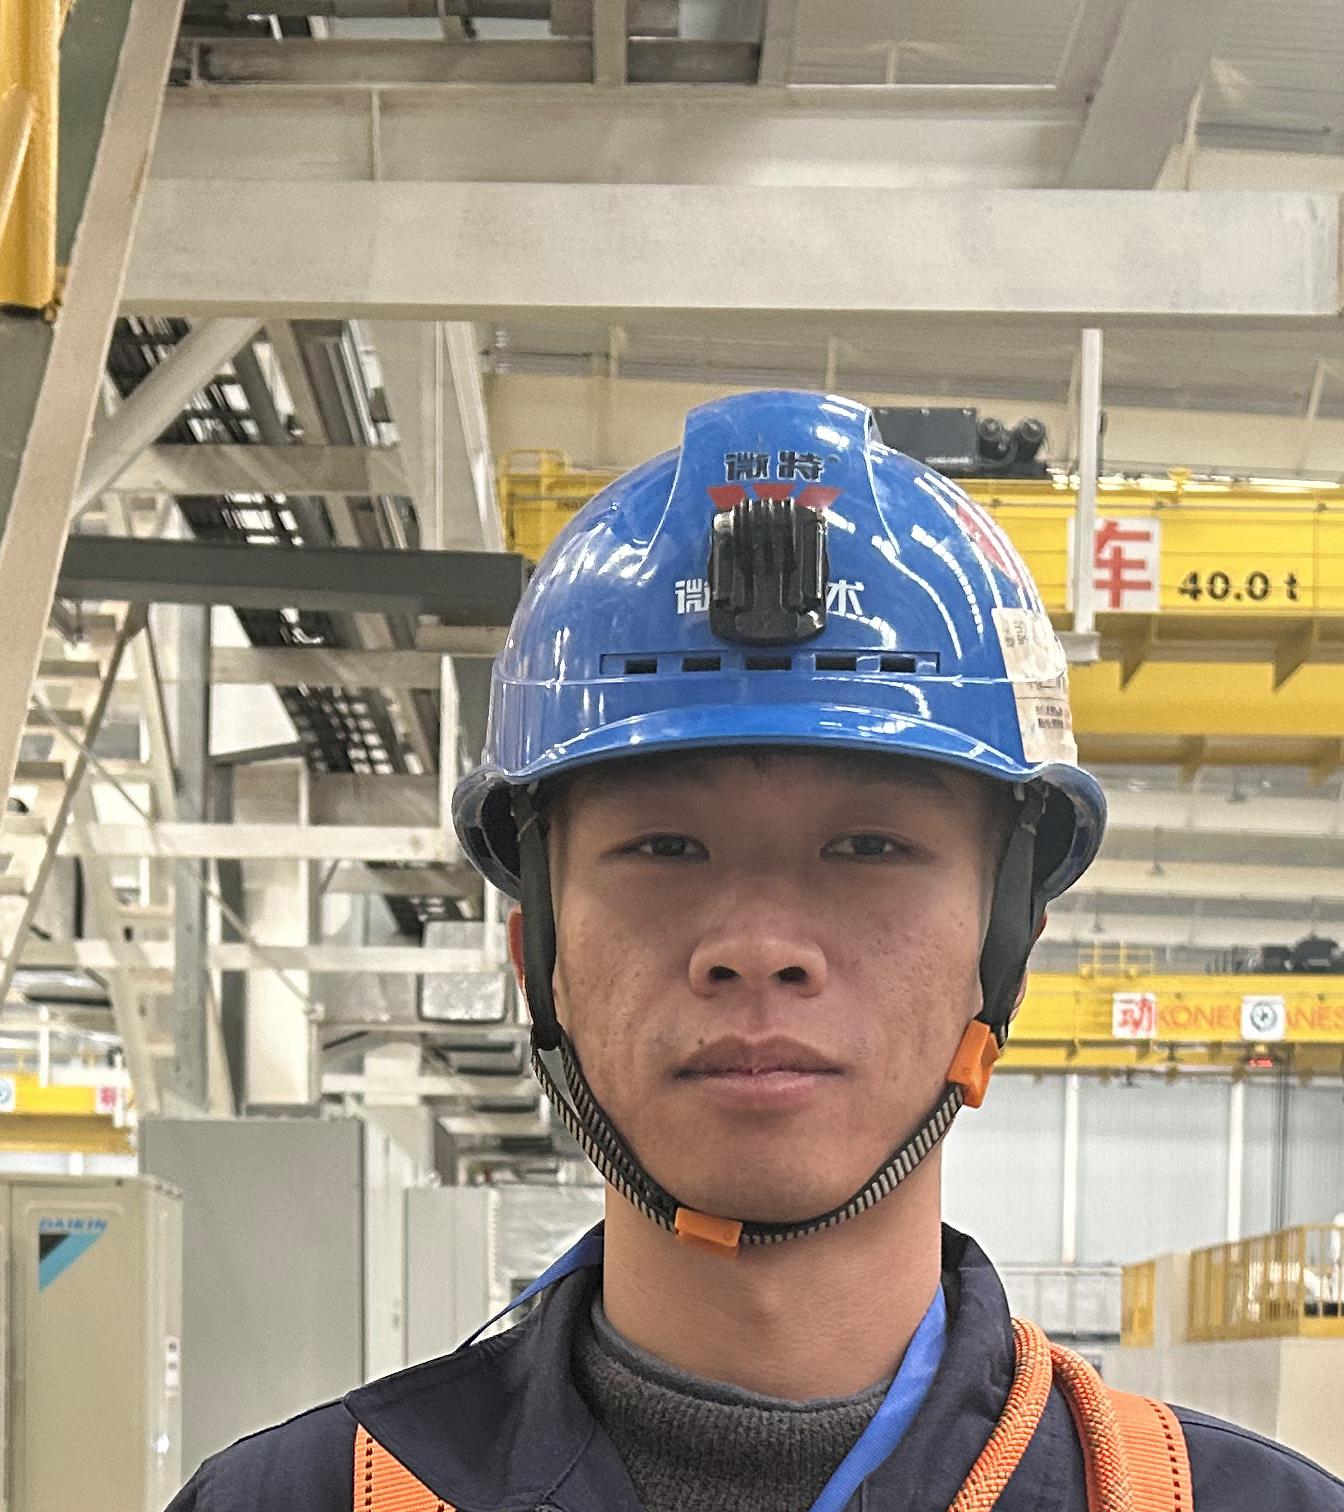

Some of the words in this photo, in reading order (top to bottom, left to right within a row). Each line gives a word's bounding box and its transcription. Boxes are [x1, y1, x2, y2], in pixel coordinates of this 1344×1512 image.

[723, 450, 825, 482] 微特
[1092, 520, 1152, 609] 车
[1177, 570, 1270, 601] 40.0
